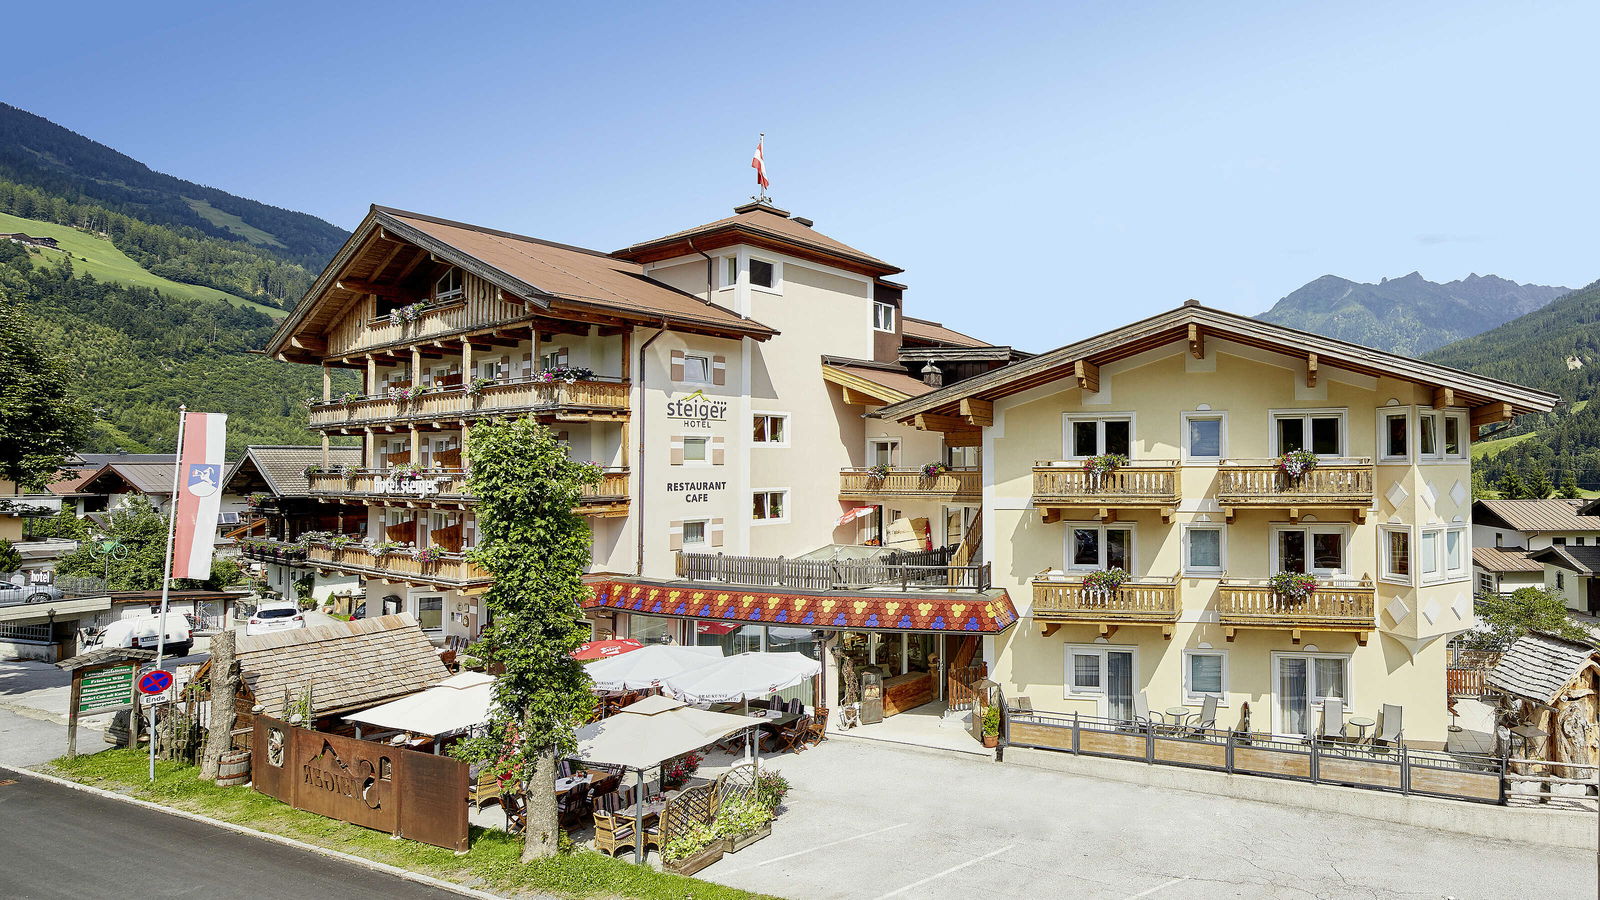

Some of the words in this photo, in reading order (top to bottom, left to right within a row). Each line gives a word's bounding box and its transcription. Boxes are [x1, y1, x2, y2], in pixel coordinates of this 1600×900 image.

[667, 399, 727, 421] steiger
[683, 420, 711, 428] HOTEL
[374, 475, 399, 494] hotel
[666, 481, 727, 492] RESTAURANT
[685, 493, 708, 503] CAFE
[31, 570, 50, 583] hotel
[145, 695, 166, 704] Ende
